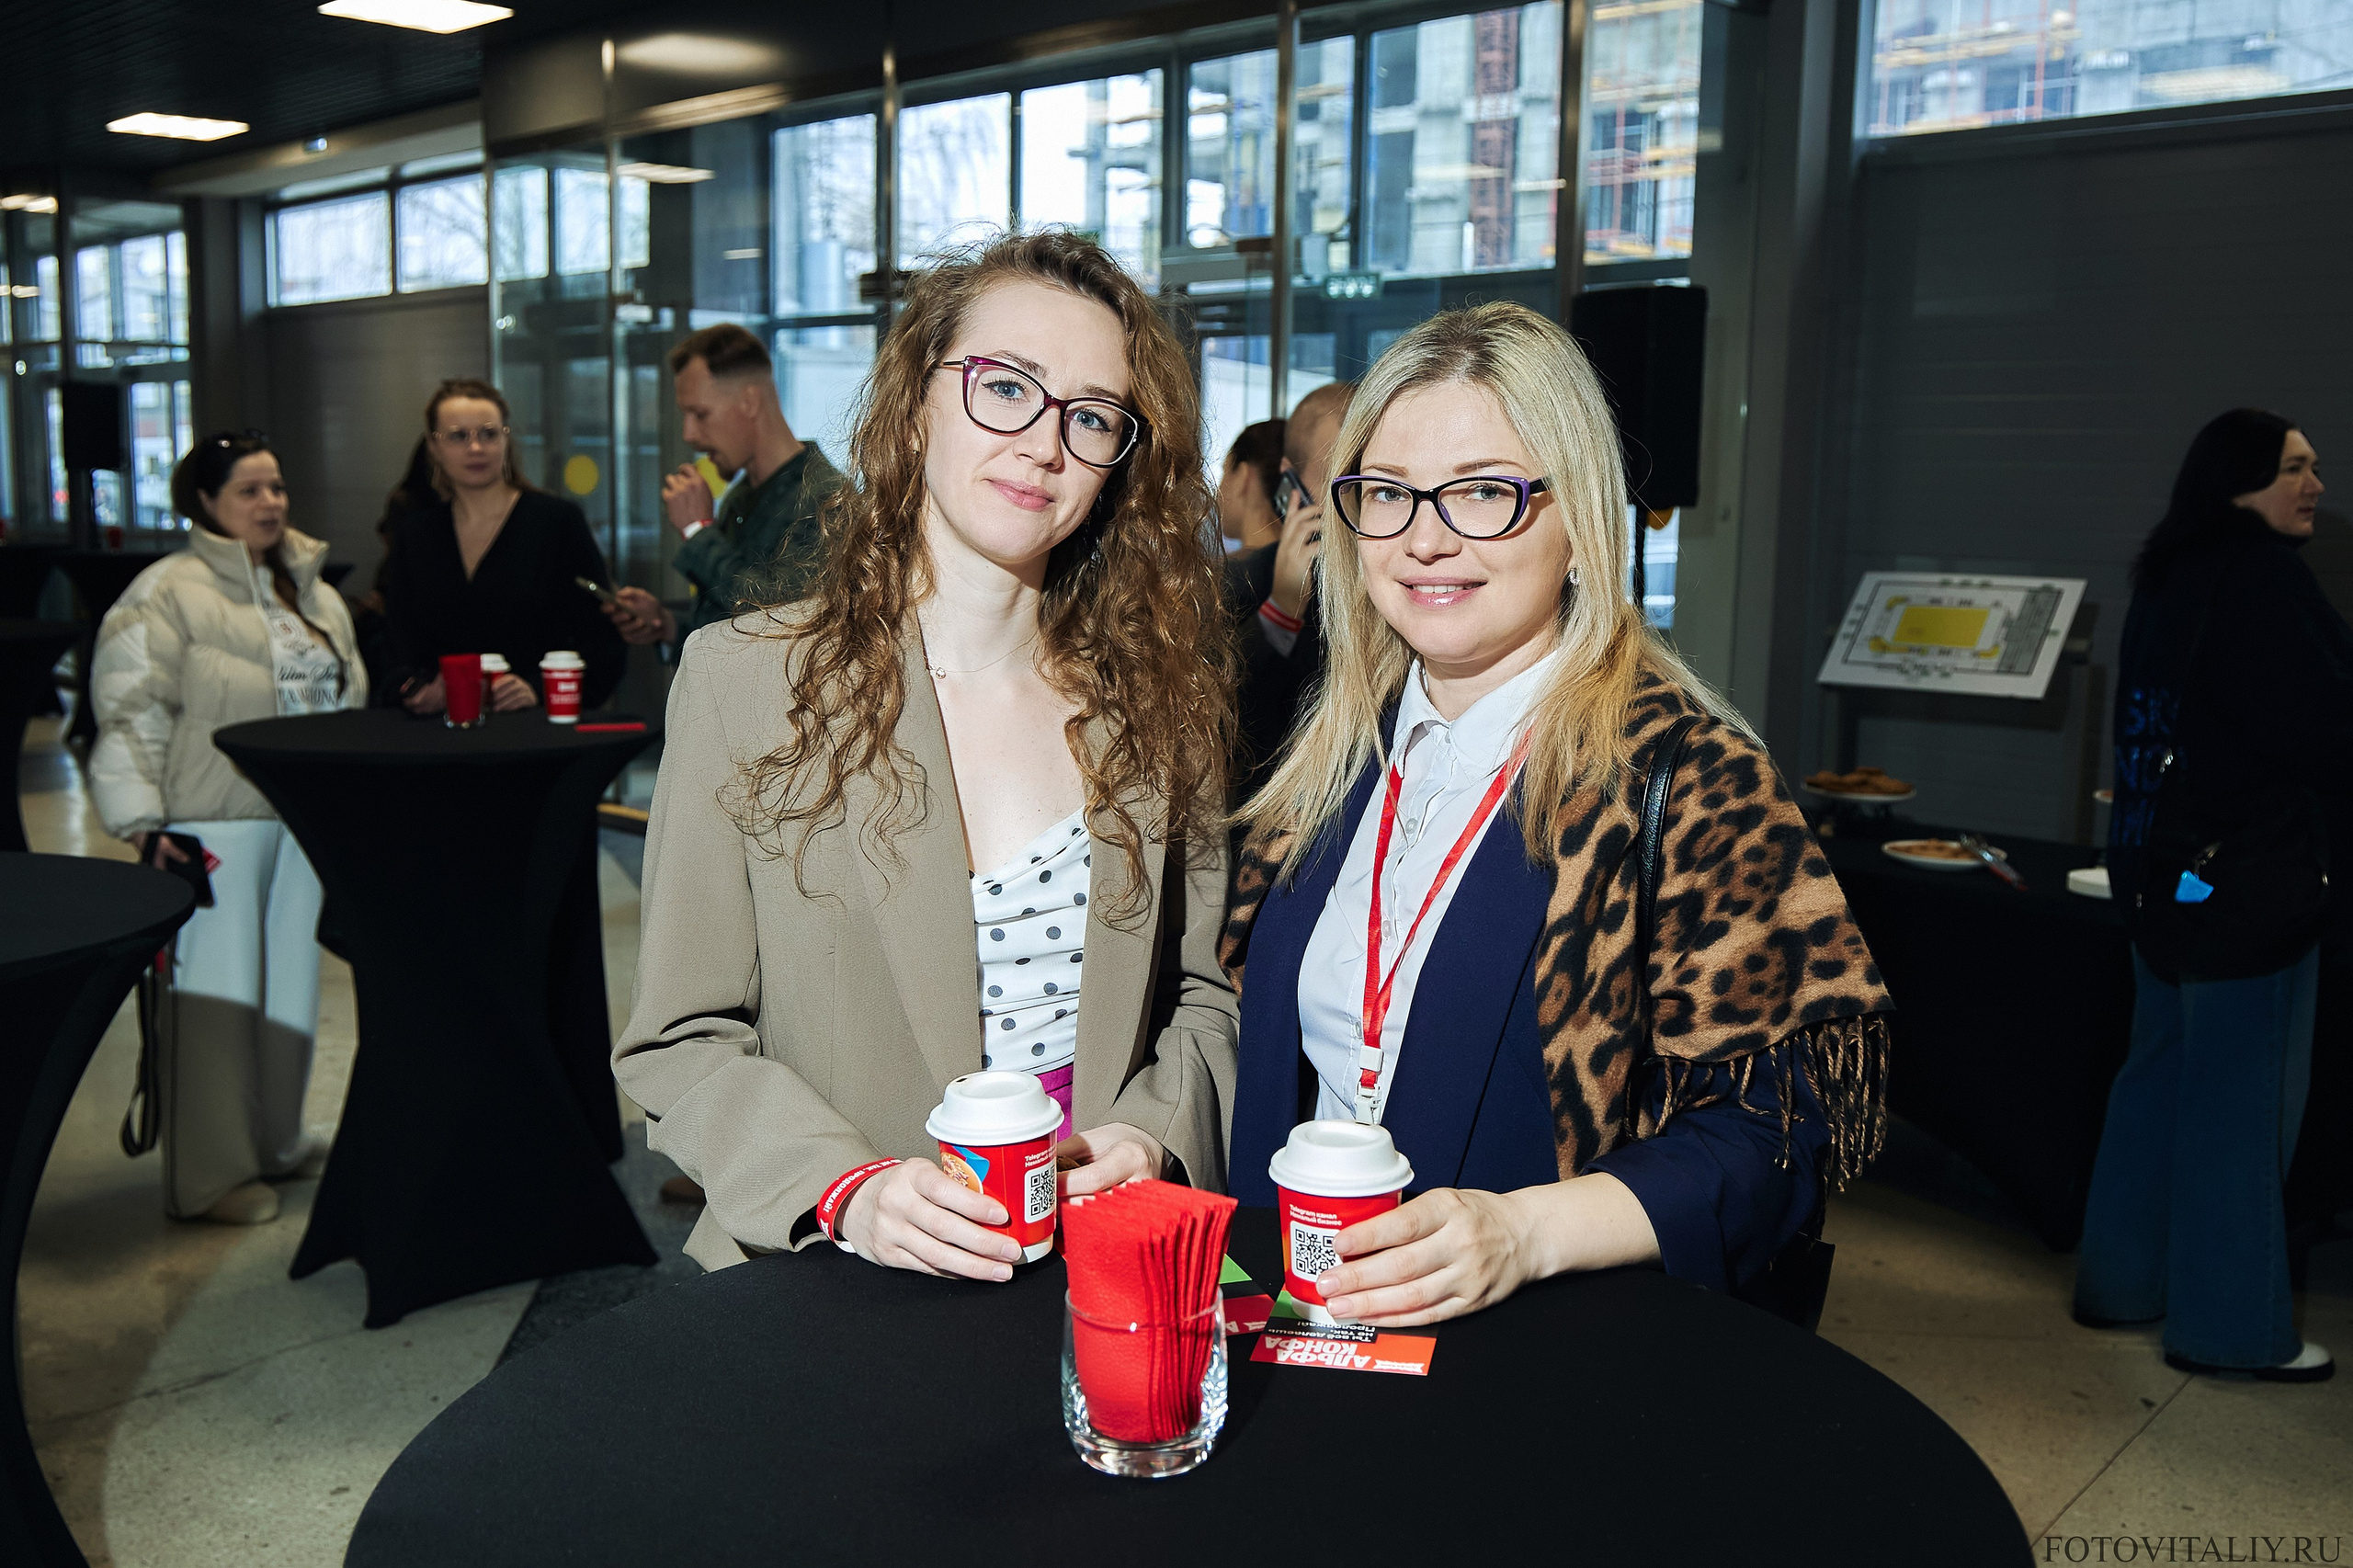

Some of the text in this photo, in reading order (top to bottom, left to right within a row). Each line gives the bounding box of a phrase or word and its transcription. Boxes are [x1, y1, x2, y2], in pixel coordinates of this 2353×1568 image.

[823, 1170, 866, 1213] ПРОДОЛЖАЙ!
[1267, 1328, 1326, 1338] делаешь
[1264, 1336, 1358, 1357] КОНФА
[1276, 1348, 1372, 1369] АЛЬФА
